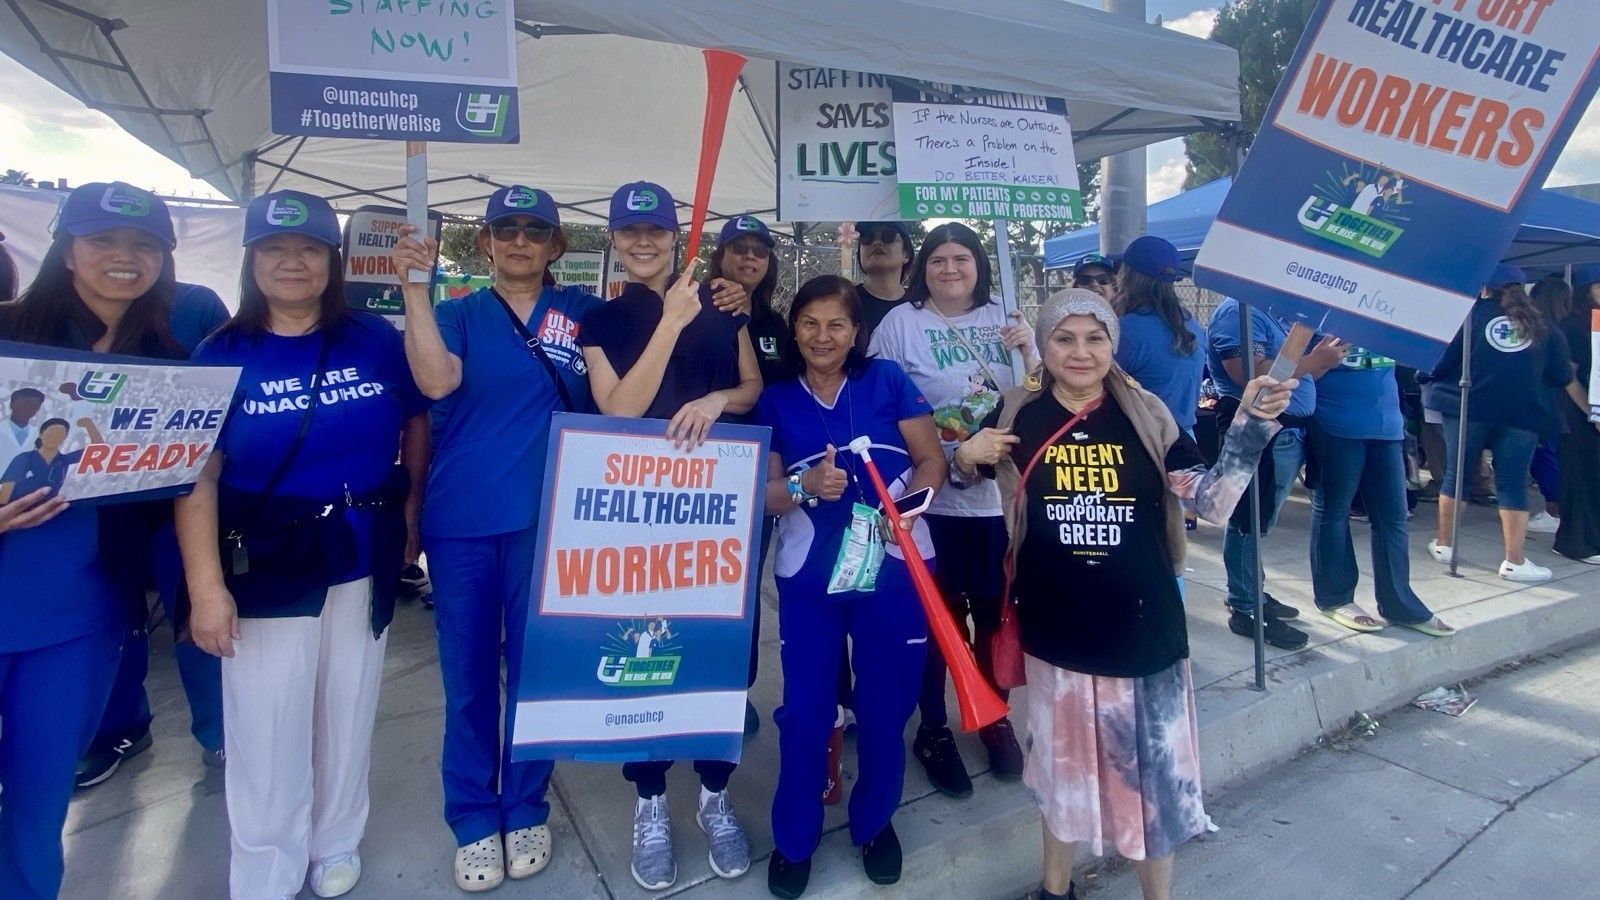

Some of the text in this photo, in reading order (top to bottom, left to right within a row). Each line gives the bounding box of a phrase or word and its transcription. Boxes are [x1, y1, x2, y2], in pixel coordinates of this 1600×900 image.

[788, 67, 891, 90] STAFFIN
[323, 86, 418, 110] @unacuhcp
[300, 109, 441, 133] #TogetherWeRise
[816, 102, 890, 129] SAVES
[912, 108, 1062, 135] If the Nurses are Outside
[1297, 52, 1546, 170] WORKERS
[915, 134, 1058, 155] There's a Problem on the
[796, 140, 897, 177] LIVES
[964, 155, 1016, 173] Inside!
[935, 170, 955, 182] DO
[965, 171, 1007, 182] BETTER
[915, 186, 1011, 201] FOR MY PATIENTS
[968, 201, 1073, 219] AND MY PROFESSION
[358, 232, 399, 248] HEALTH
[562, 271, 599, 282] Together
[565, 260, 600, 270] Together
[1285, 261, 1358, 294] @unacuhcp
[547, 313, 575, 334] ULP
[260, 377, 303, 396] WE
[243, 382, 384, 415] UNACUHCP
[110, 407, 223, 431] WE ARE
[77, 442, 209, 475] READY
[718, 443, 753, 458] NICU
[1044, 443, 1124, 466] PATIENT
[604, 452, 718, 488] SUPPORT
[1056, 466, 1119, 492] NEED
[573, 487, 738, 526] HEALTHCARE
[1073, 487, 1105, 506] not
[1046, 504, 1135, 522] CORPORATE
[1059, 523, 1121, 546] GREED
[556, 537, 742, 598] WORKERS
[605, 710, 664, 726] @unacuhcp
